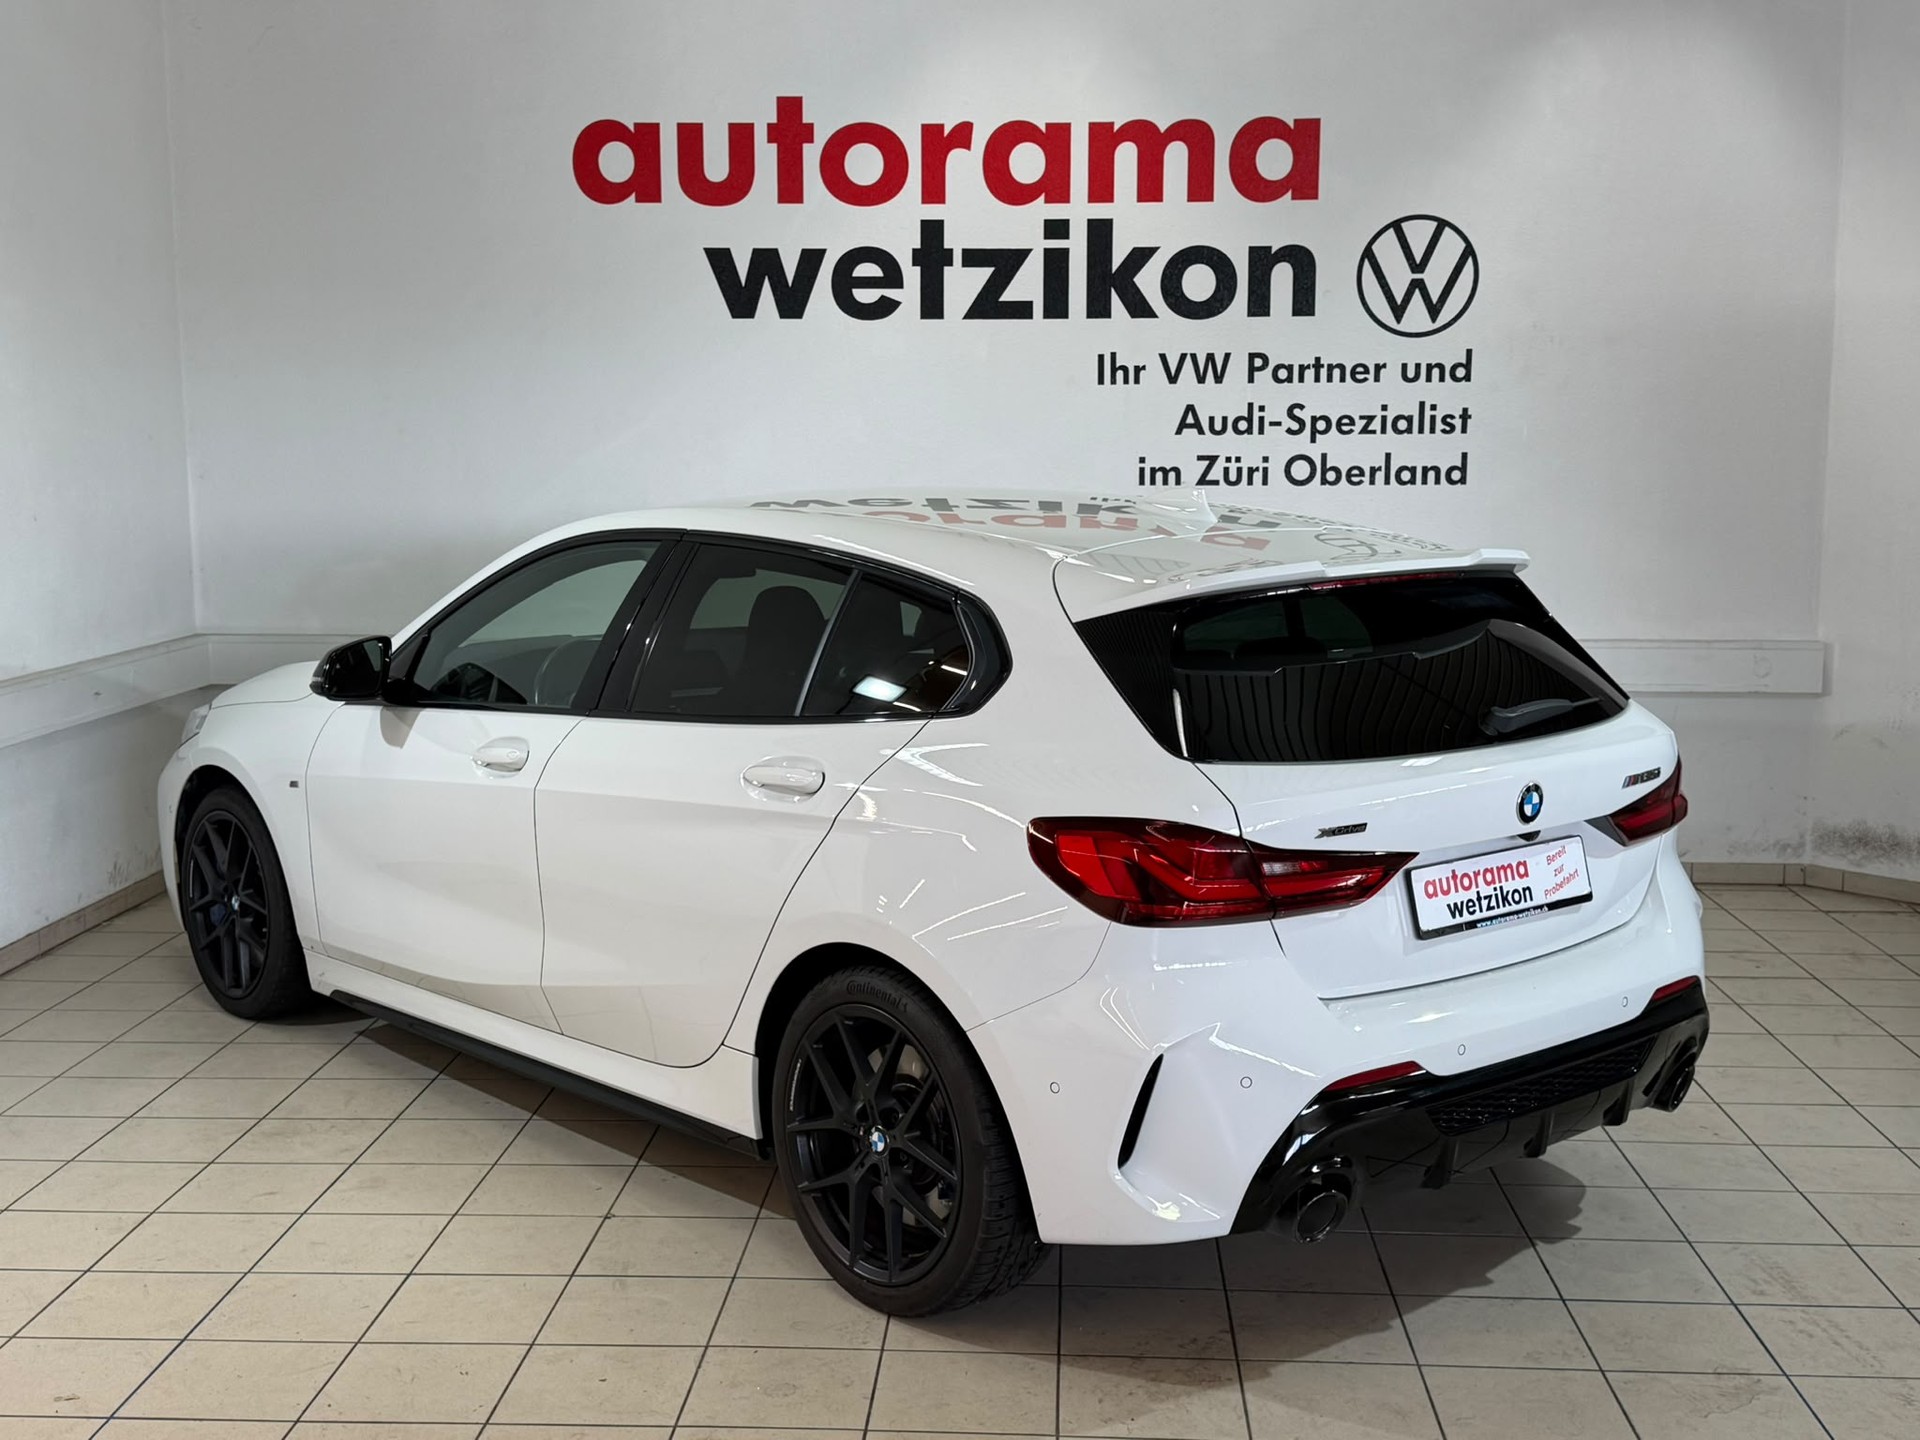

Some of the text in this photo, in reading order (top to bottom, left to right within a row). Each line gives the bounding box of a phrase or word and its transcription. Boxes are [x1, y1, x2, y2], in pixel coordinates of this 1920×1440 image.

[572, 96, 1321, 207] autorama
[703, 218, 1317, 321] wetzikon
[1097, 348, 1473, 386] Ihr VW Partner und
[1174, 400, 1473, 443] Audi-Spezialist
[1138, 451, 1469, 487] im Züri Oberland
[1545, 844, 1567, 866] Bereit
[1553, 863, 1565, 878] zur
[1423, 859, 1530, 900] autorama
[1543, 867, 1579, 900] Probefahrt
[1447, 885, 1534, 920] wetzikon
